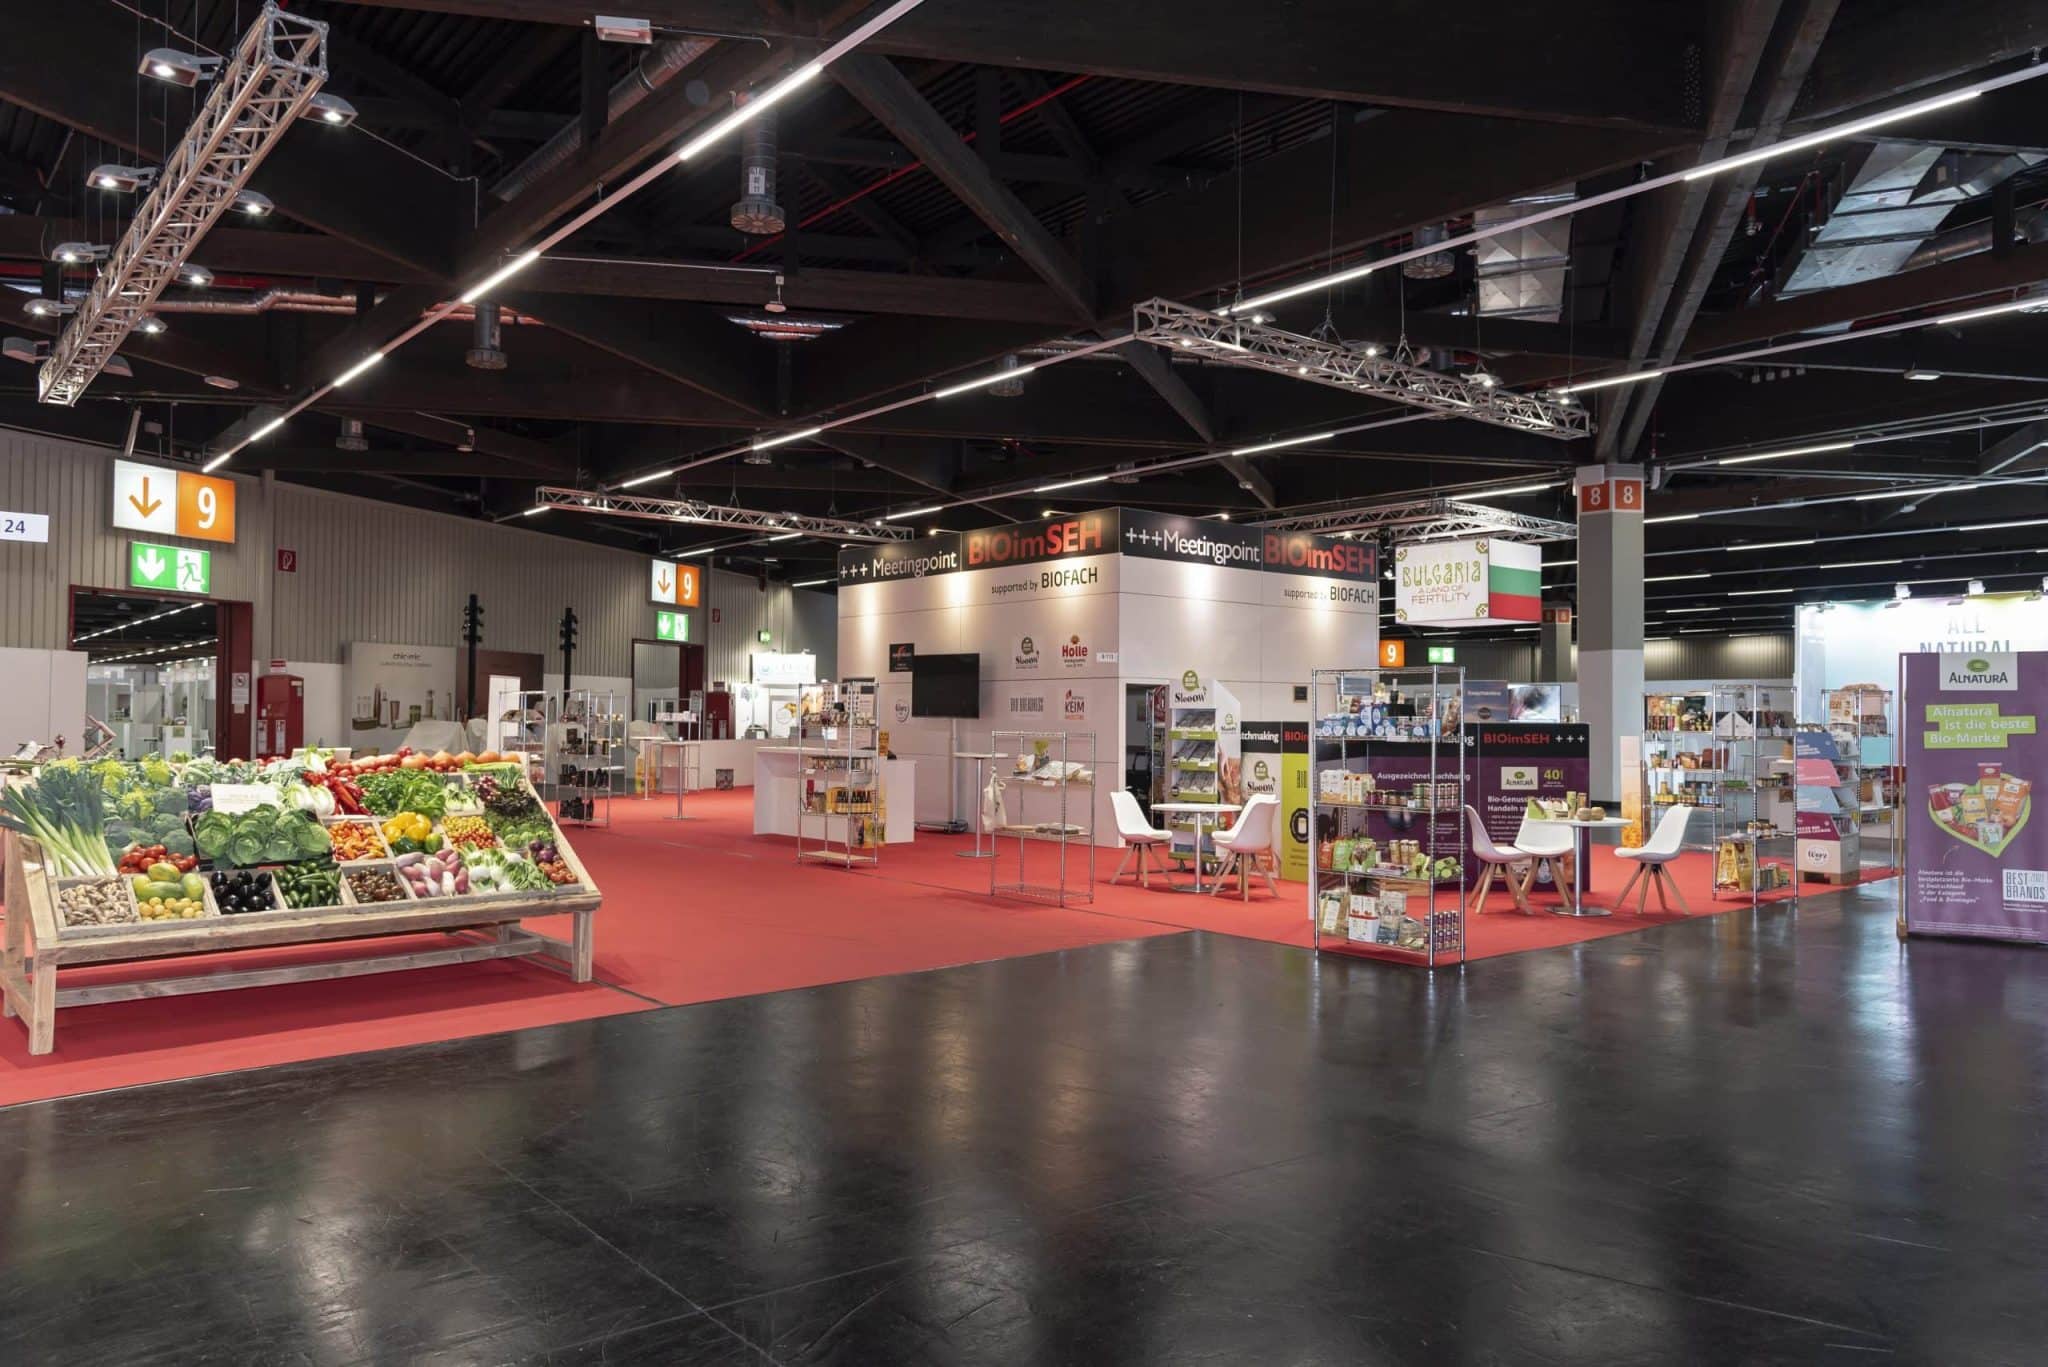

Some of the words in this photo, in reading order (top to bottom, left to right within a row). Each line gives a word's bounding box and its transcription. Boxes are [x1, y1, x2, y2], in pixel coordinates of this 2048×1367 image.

[1589, 487, 1601, 505] 8
[1623, 485, 1634, 504] 8
[197, 487, 217, 529] 9
[4, 519, 26, 535] 24
[872, 551, 958, 578] Meetingpoint
[968, 518, 1102, 565] BIOimSEH
[1264, 534, 1376, 577] BIOimSEH
[684, 572, 693, 600] 9
[991, 580, 1028, 596] supported
[1029, 578, 1038, 593] by
[1041, 566, 1099, 589] BIOFACH
[1330, 586, 1375, 605] BIOFACH
[1411, 592, 1471, 605] FERTILITY
[1062, 645, 1088, 657] Holle
[1387, 644, 1397, 663] 9
[1065, 701, 1085, 713] KEIM
[1933, 707, 1992, 717] Alnatura
[1945, 720, 1960, 730] ist
[1966, 720, 1986, 729] die
[1991, 719, 2030, 729] beste
[1484, 733, 1550, 744] BIOimSEH
[1930, 732, 2001, 744] Bio-Marke
[2006, 871, 2028, 886] BEST
[2006, 885, 2045, 900] BRANDS
